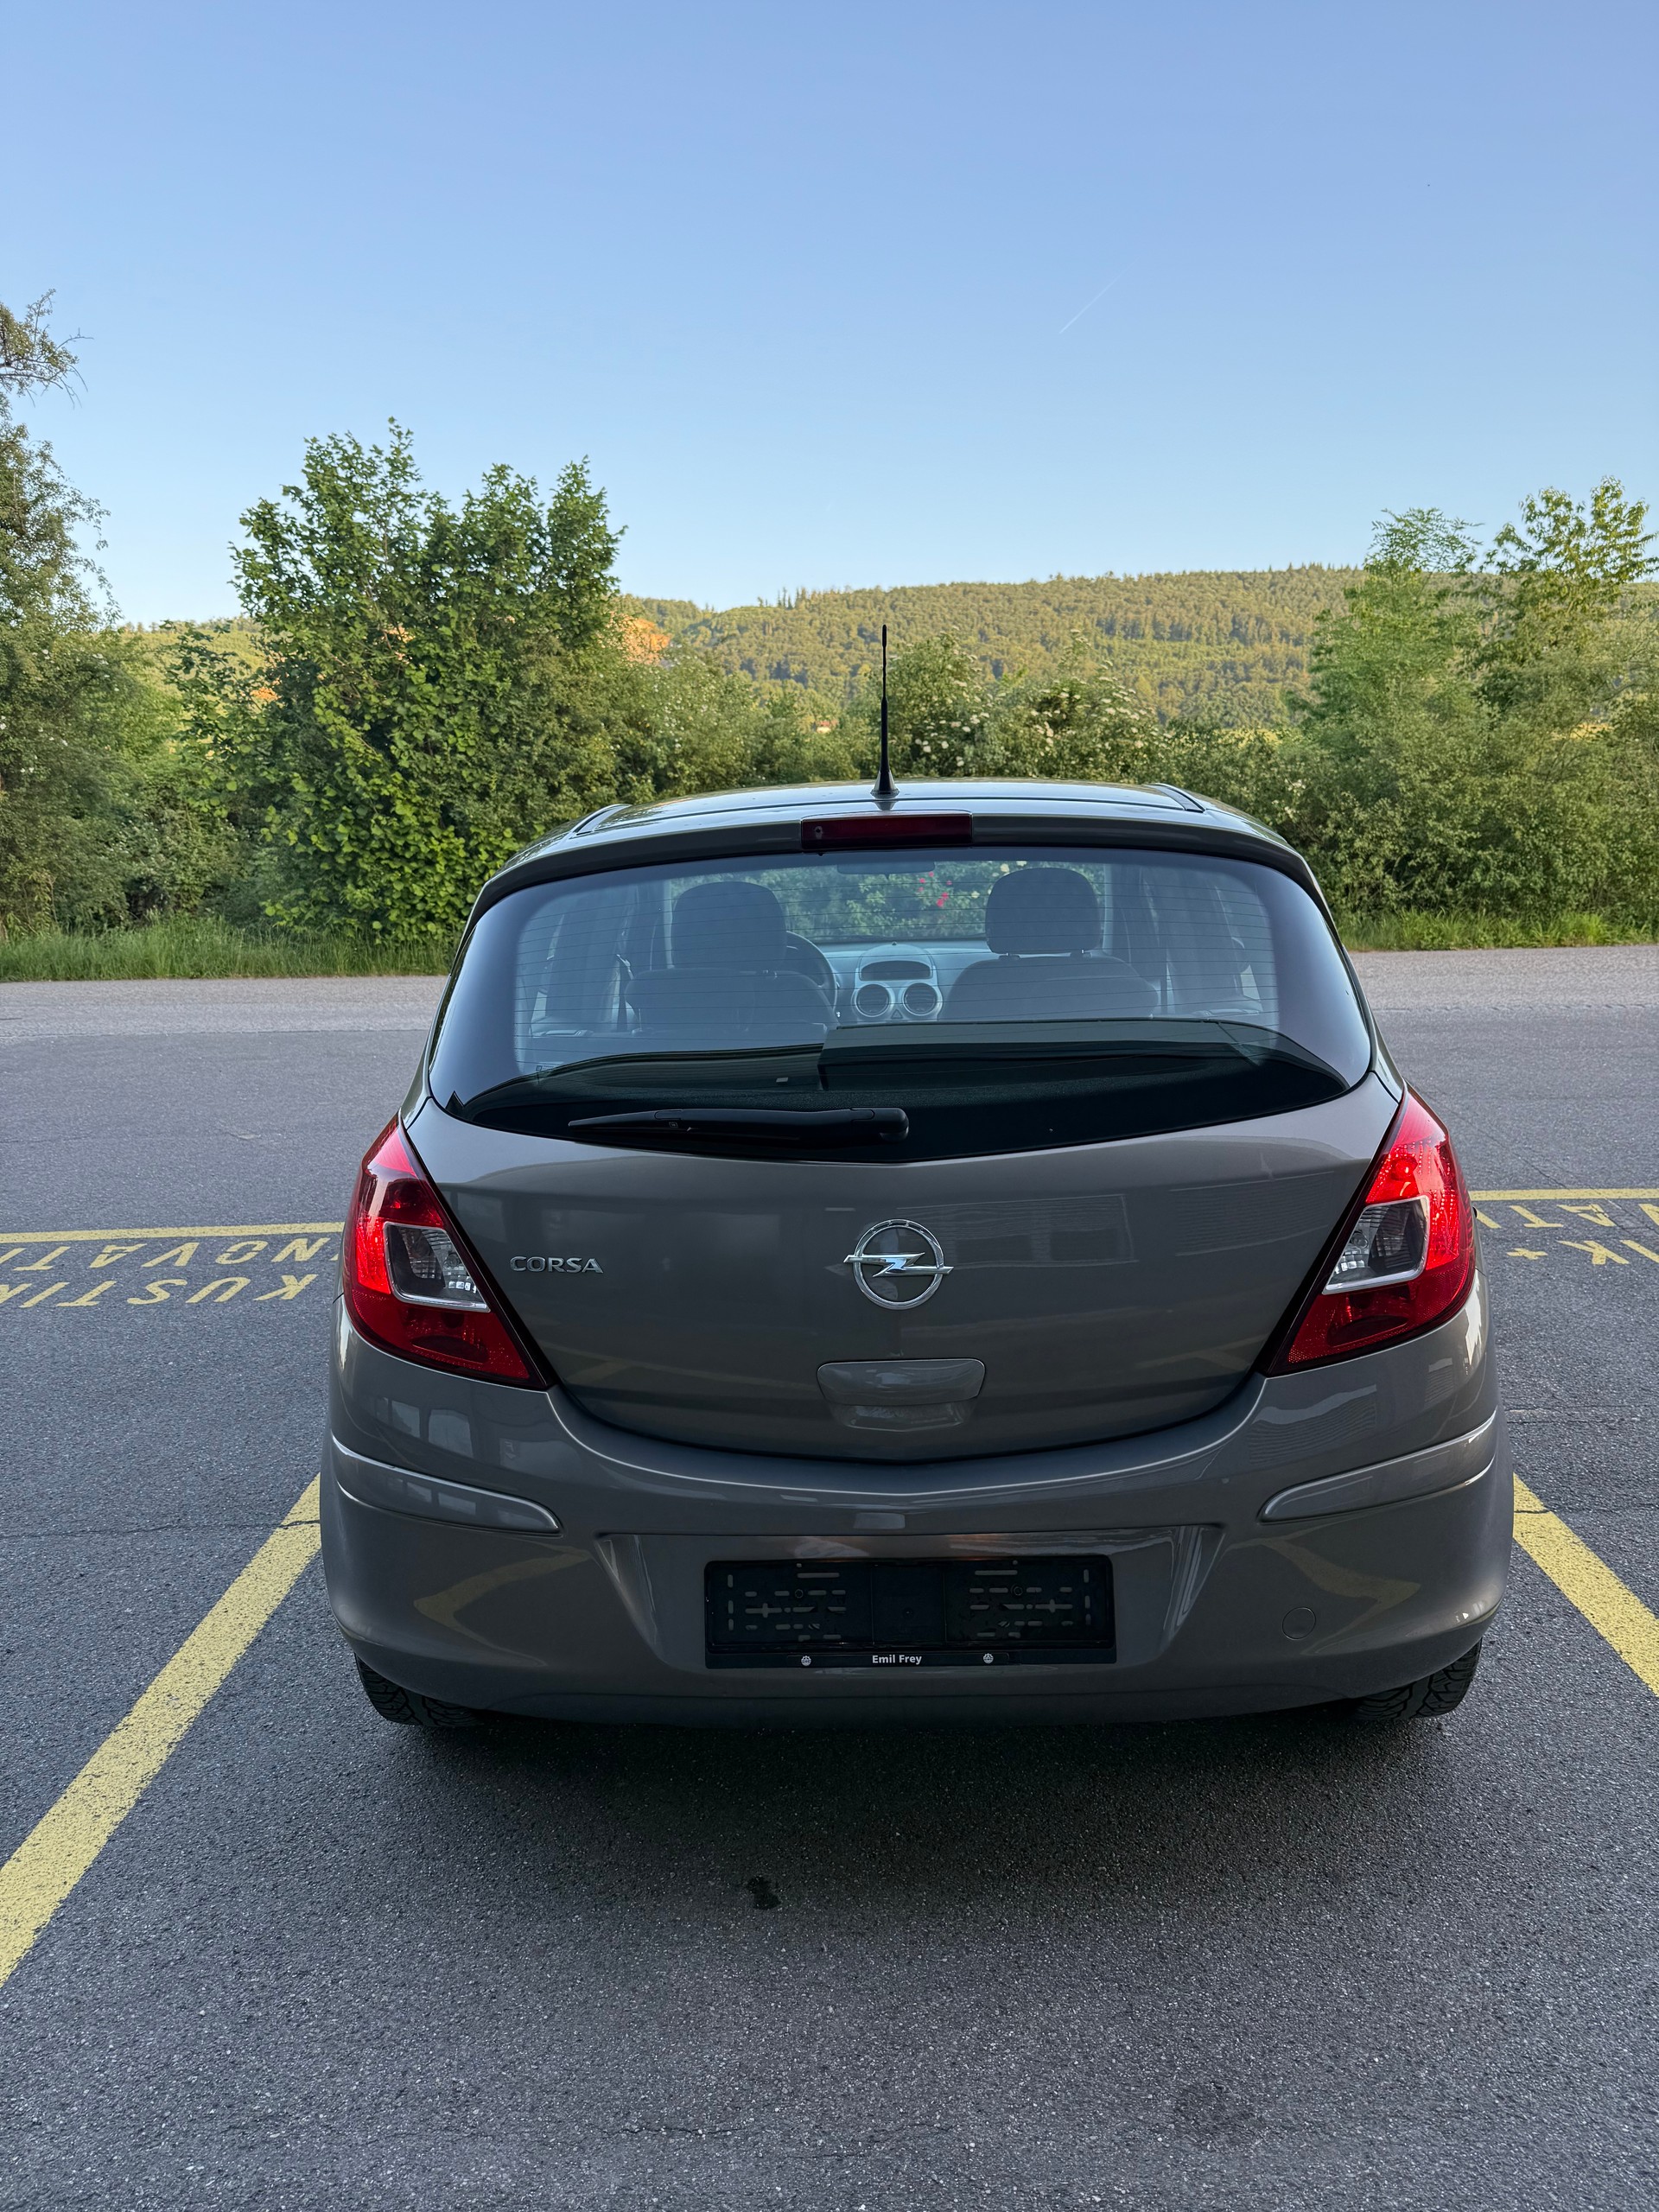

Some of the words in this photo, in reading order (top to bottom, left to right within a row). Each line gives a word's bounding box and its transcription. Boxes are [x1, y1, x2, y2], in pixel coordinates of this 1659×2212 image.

[510, 1255, 604, 1274] CORSA
[873, 1654, 896, 1663] Emil
[899, 1654, 922, 1665] Frey
